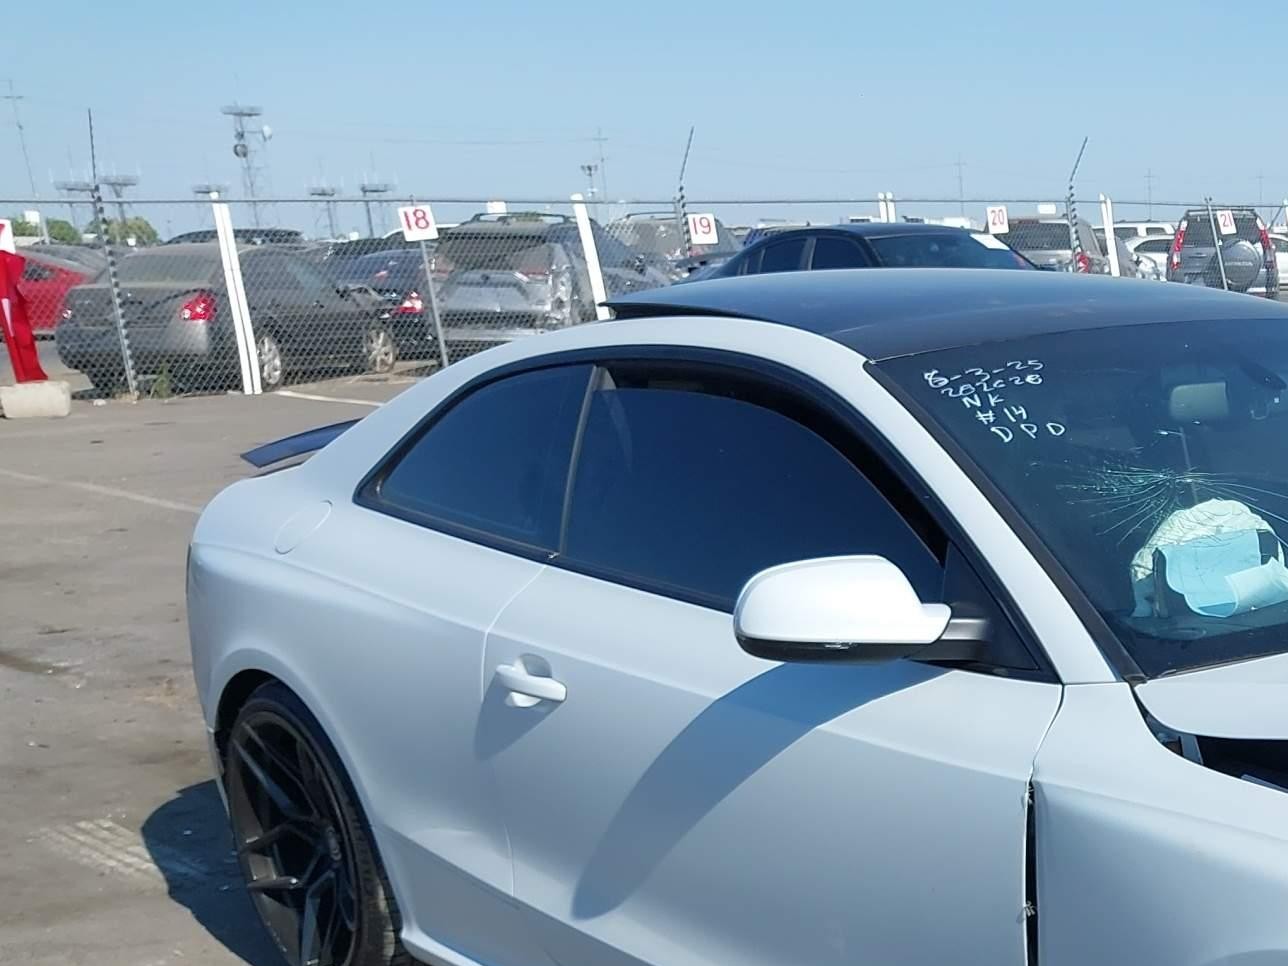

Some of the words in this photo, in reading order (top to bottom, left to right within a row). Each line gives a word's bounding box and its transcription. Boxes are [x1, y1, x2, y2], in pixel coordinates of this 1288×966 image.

[403, 208, 431, 231] 18
[692, 216, 712, 235] 19
[990, 209, 1005, 227] 20
[1219, 213, 1233, 227] 21
